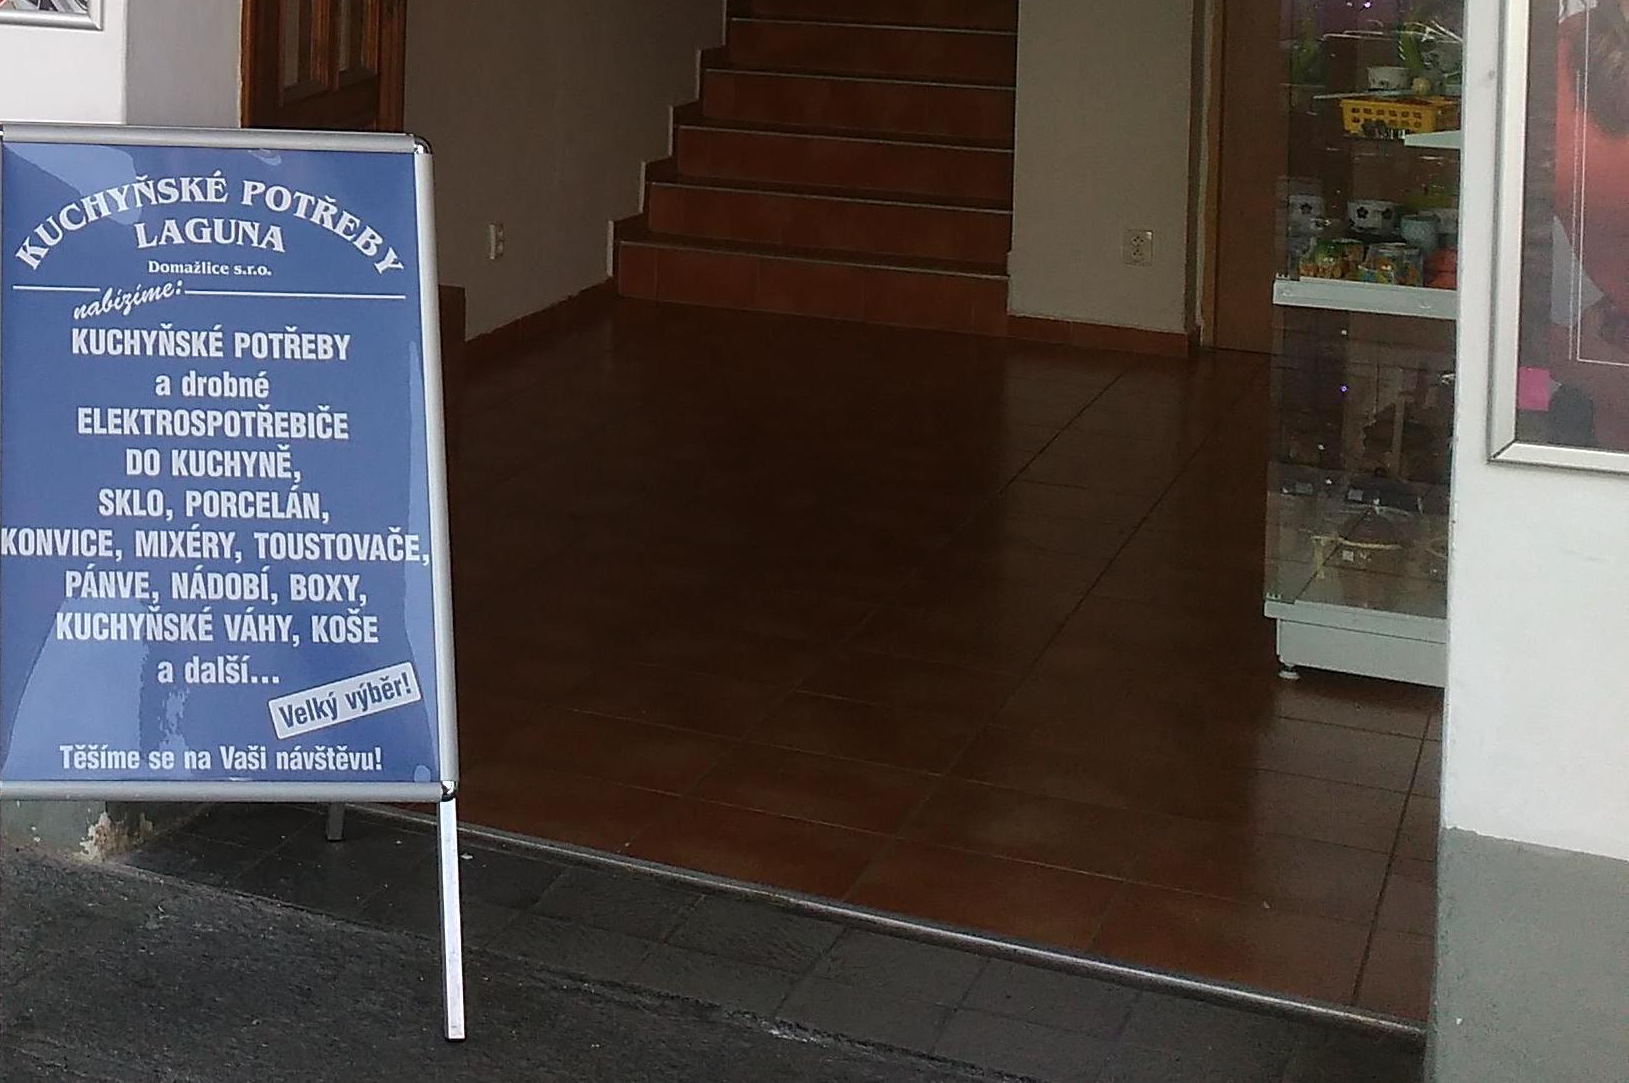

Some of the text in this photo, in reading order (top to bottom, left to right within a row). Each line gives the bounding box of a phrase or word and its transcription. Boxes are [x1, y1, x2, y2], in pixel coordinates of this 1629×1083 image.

[15, 171, 404, 276] KUCHYŇSKÉ POTŘEBY
[133, 217, 286, 253] LAGUNA
[148, 259, 272, 276] Domažlice s.r.o.
[73, 279, 184, 321] nabízíme:
[72, 323, 350, 361] KUCHYŇSKÉ POTŘEBY
[155, 370, 269, 399] a drobné
[78, 403, 349, 440] ELEKTROSPOTŘEBIČE
[125, 443, 302, 483] DO KUCHYNĚ,
[98, 485, 330, 525] SKLO, PORCELÁN,
[1, 524, 430, 566] KONVICE, MIXÉRY, TOUSTOVAČE,
[66, 565, 367, 607] PÁNVE, NÁDOBÍ, BOXY,
[56, 606, 379, 647] KUCHYŇSKÉ VÁHY, KOŠE
[157, 661, 174, 683] a
[279, 671, 413, 729] Velký výběr!
[59, 744, 383, 771] Těšíme se na Vaši návštěvu!
